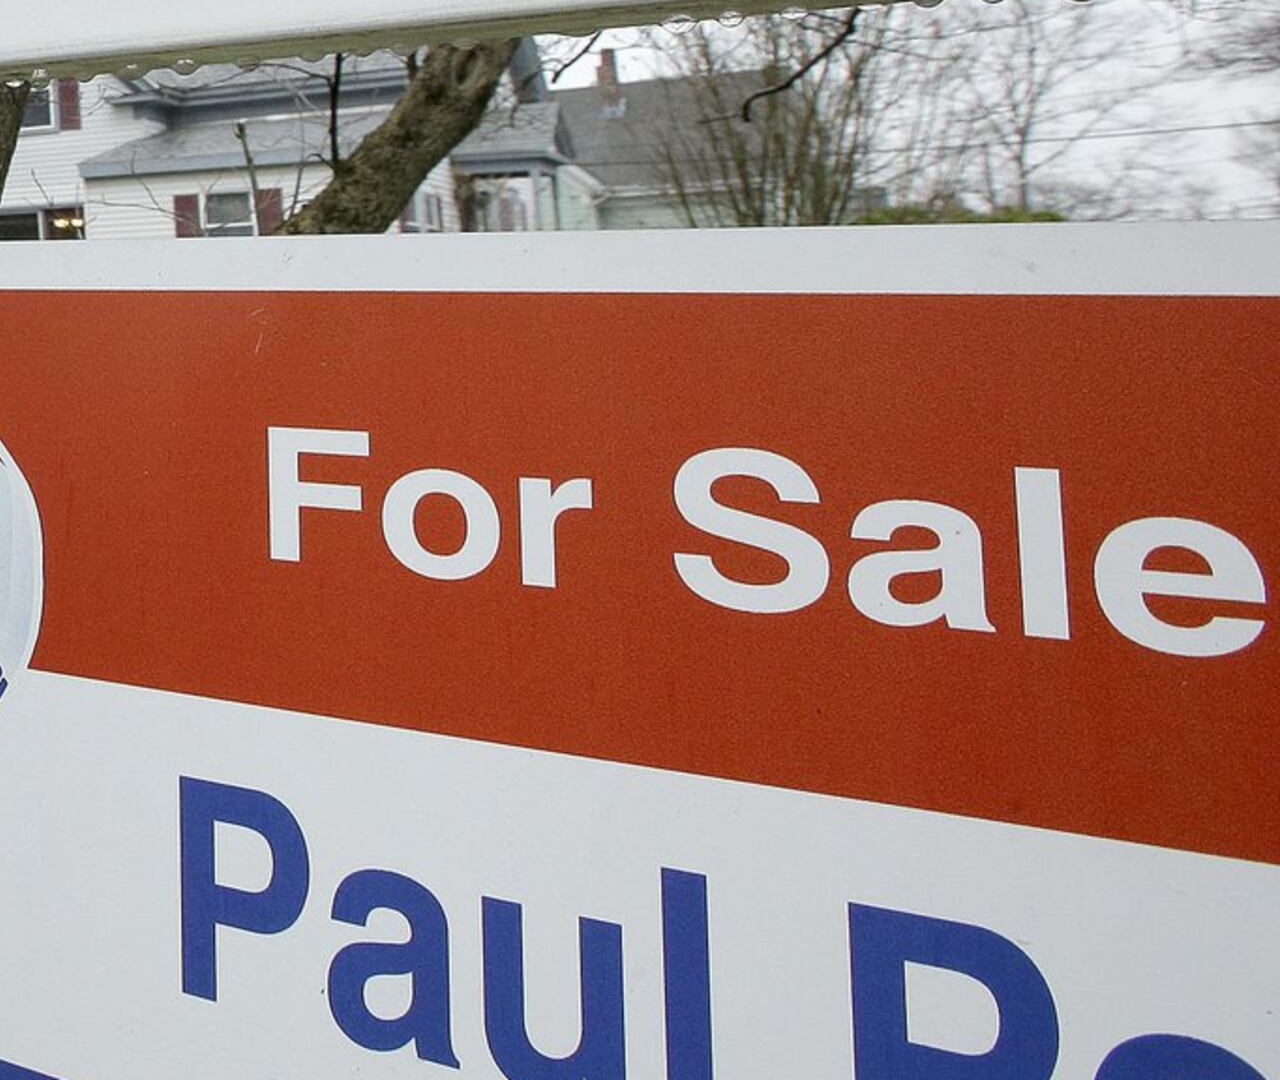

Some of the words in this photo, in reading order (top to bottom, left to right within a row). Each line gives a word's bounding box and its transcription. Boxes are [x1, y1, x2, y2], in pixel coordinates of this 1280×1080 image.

[267, 426, 594, 589] For
[672, 446, 1268, 658] Sale
[180, 776, 714, 1080] Paul
